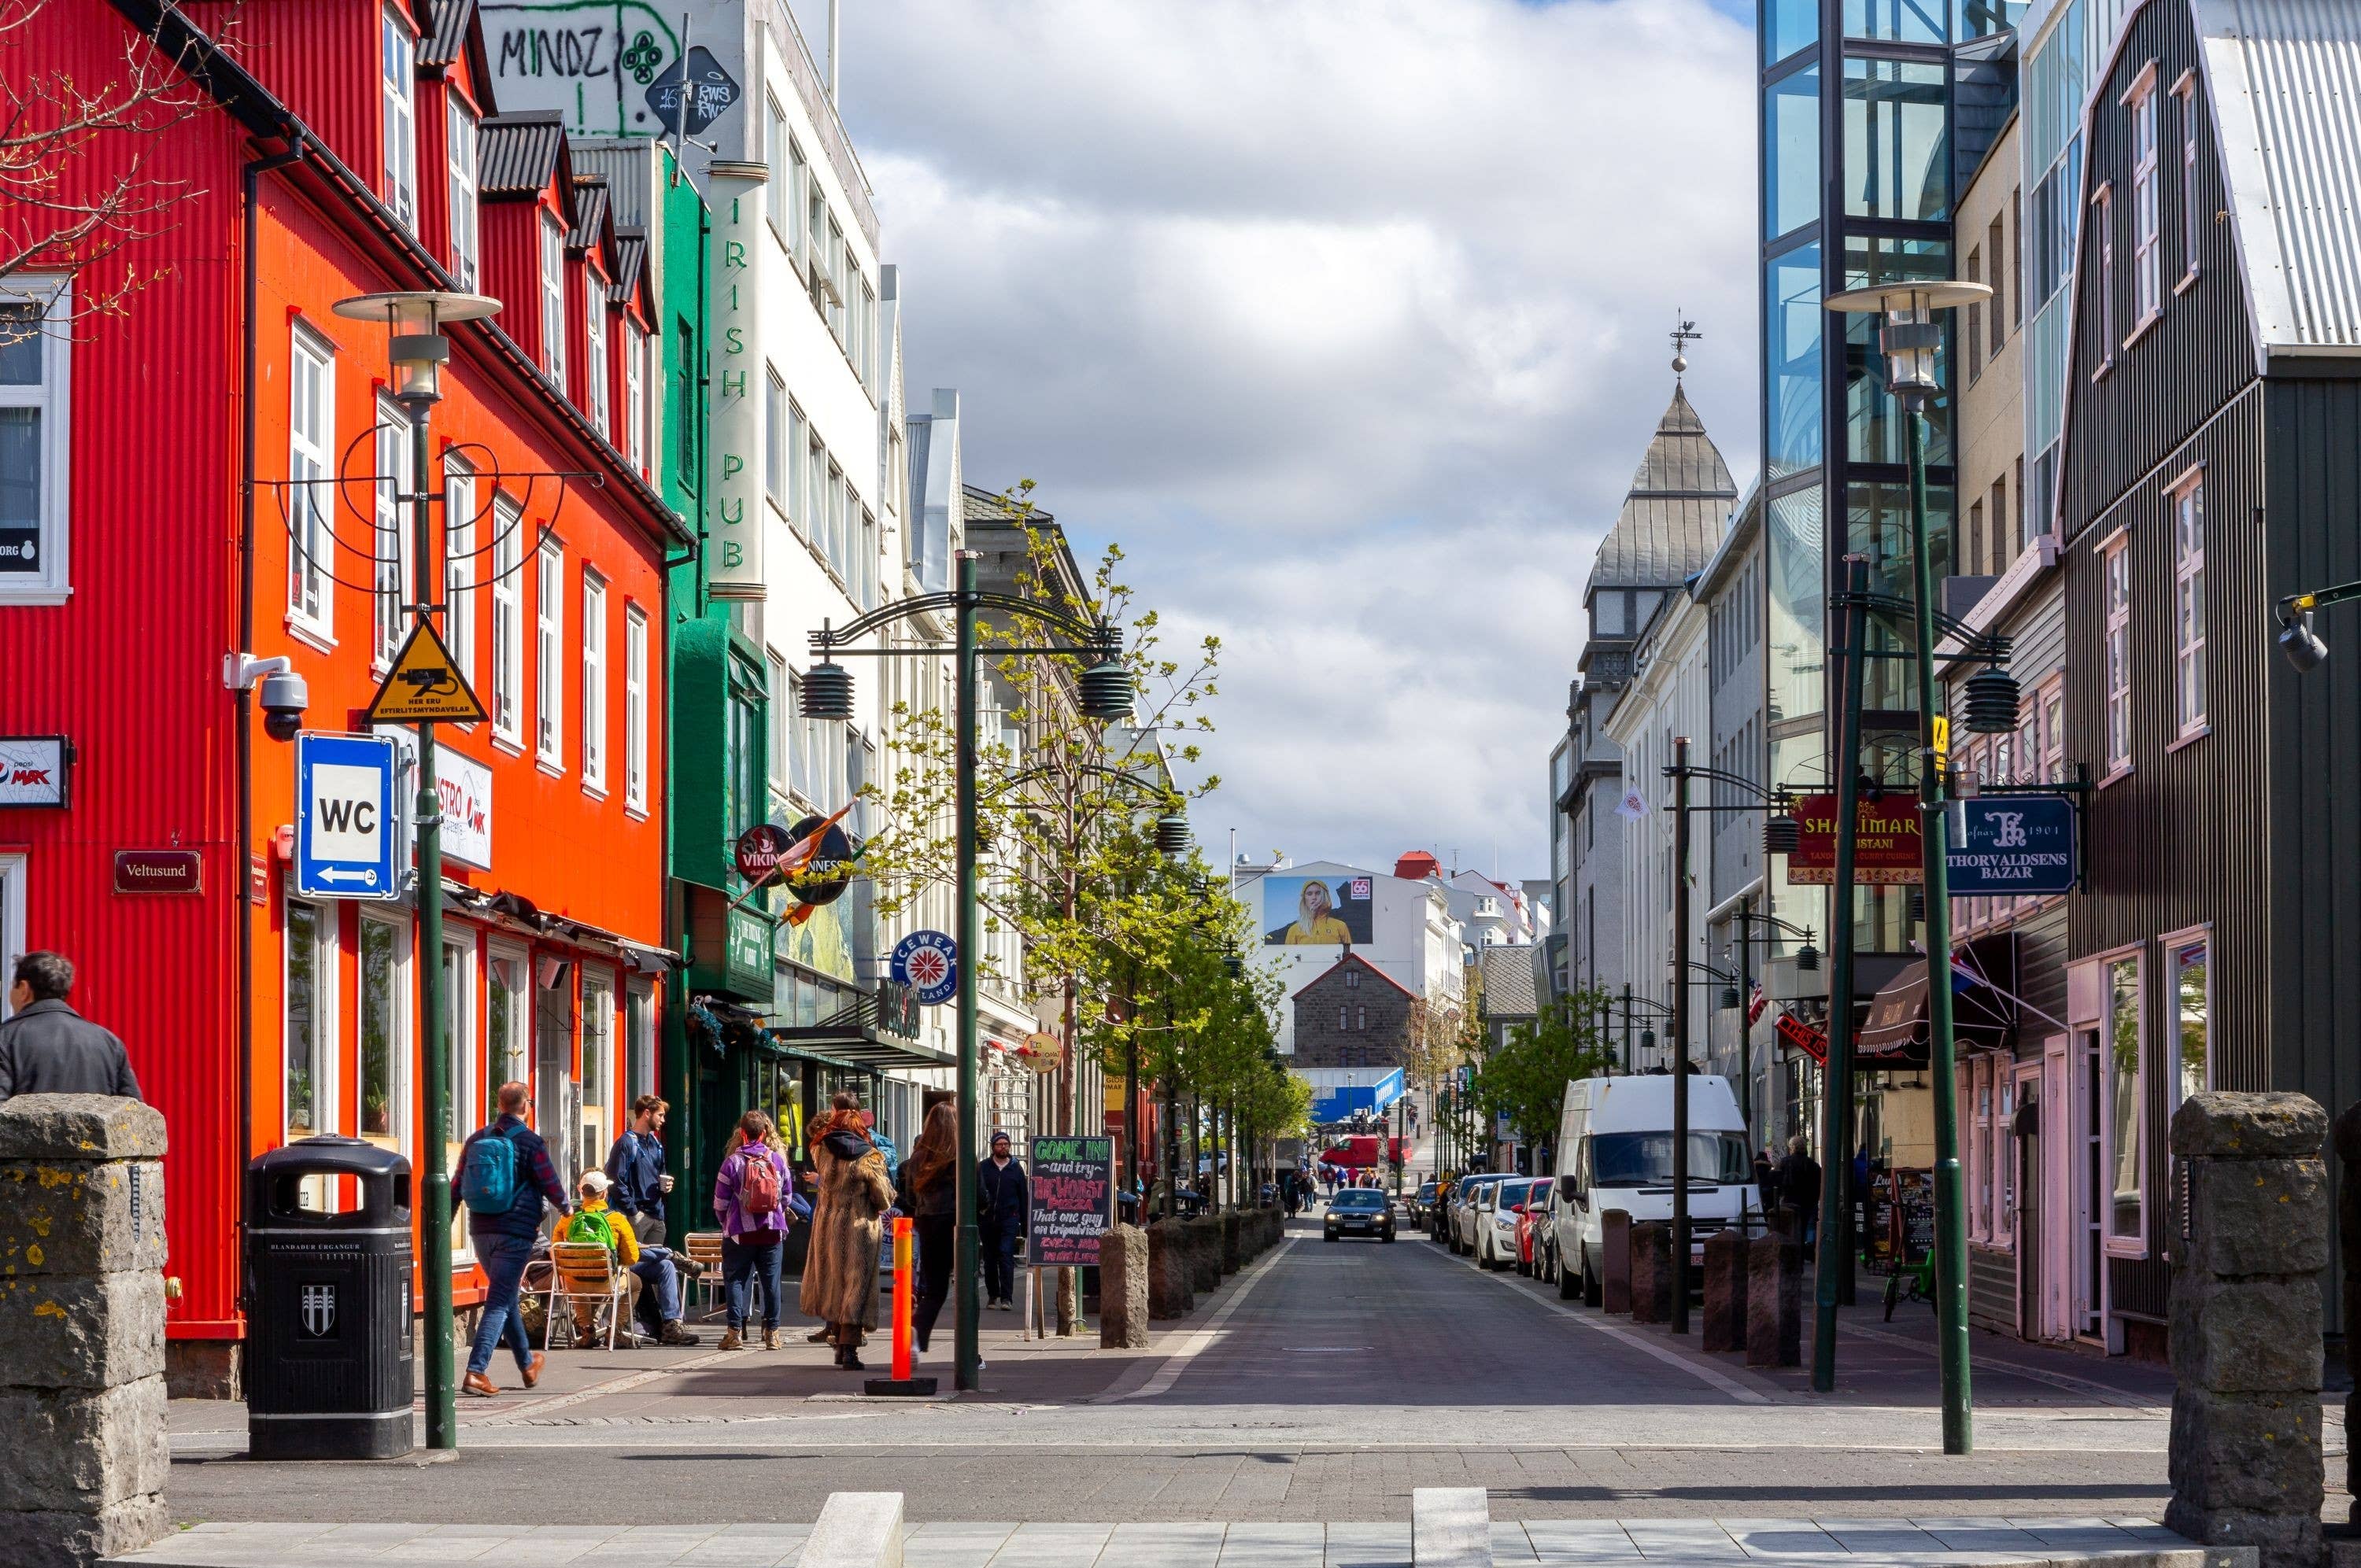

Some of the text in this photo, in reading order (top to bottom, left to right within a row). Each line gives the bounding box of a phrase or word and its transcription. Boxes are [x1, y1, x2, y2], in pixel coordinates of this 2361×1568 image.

[699, 85, 731, 102] RWS
[721, 197, 748, 567] IRISH PUB
[11, 769, 52, 786] MAX
[434, 775, 462, 818] ISTRO
[319, 798, 375, 835] WC
[2029, 826, 2059, 836] 1901
[1945, 853, 2067, 867] THORVALDSENS
[126, 864, 187, 876] Veltusund
[1981, 866, 2034, 880] BAZAR
[921, 983, 951, 999] LAND
[1786, 1020, 1824, 1054] THIS IS
[1035, 1140, 1083, 1161] COME
[1049, 1161, 1095, 1179] and try
[1031, 1176, 1107, 1200] THE WORST
[1047, 1197, 1095, 1212] PIZZA
[1033, 1209, 1104, 1227] That one guy
